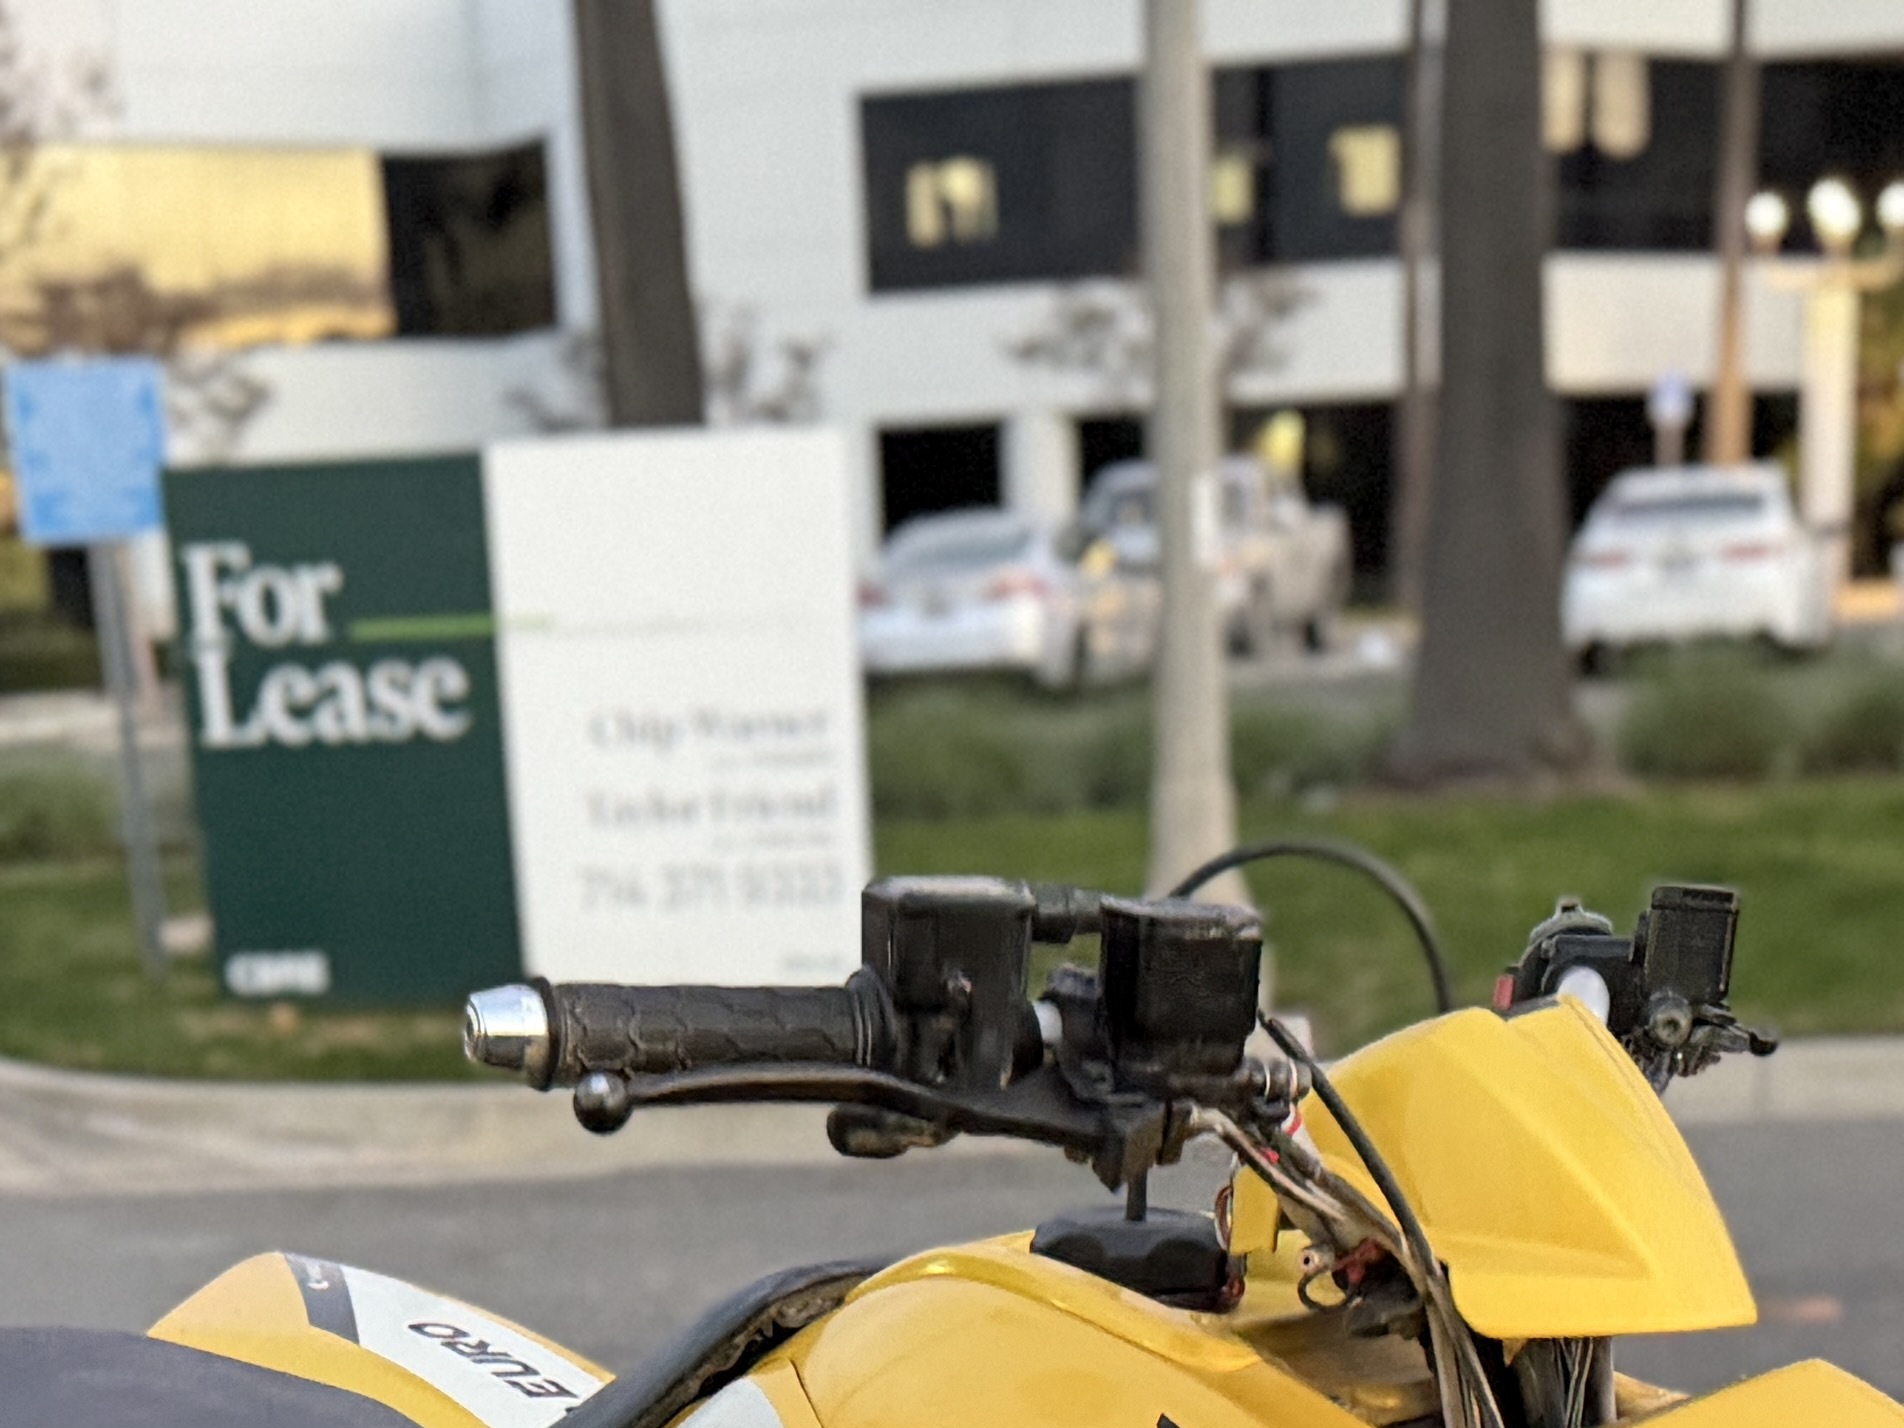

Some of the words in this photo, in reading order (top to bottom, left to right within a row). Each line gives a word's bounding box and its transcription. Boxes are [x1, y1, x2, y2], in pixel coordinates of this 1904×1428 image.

[183, 540, 343, 648] For
[194, 642, 471, 748] Lease
[407, 1322, 579, 1399] EURO
